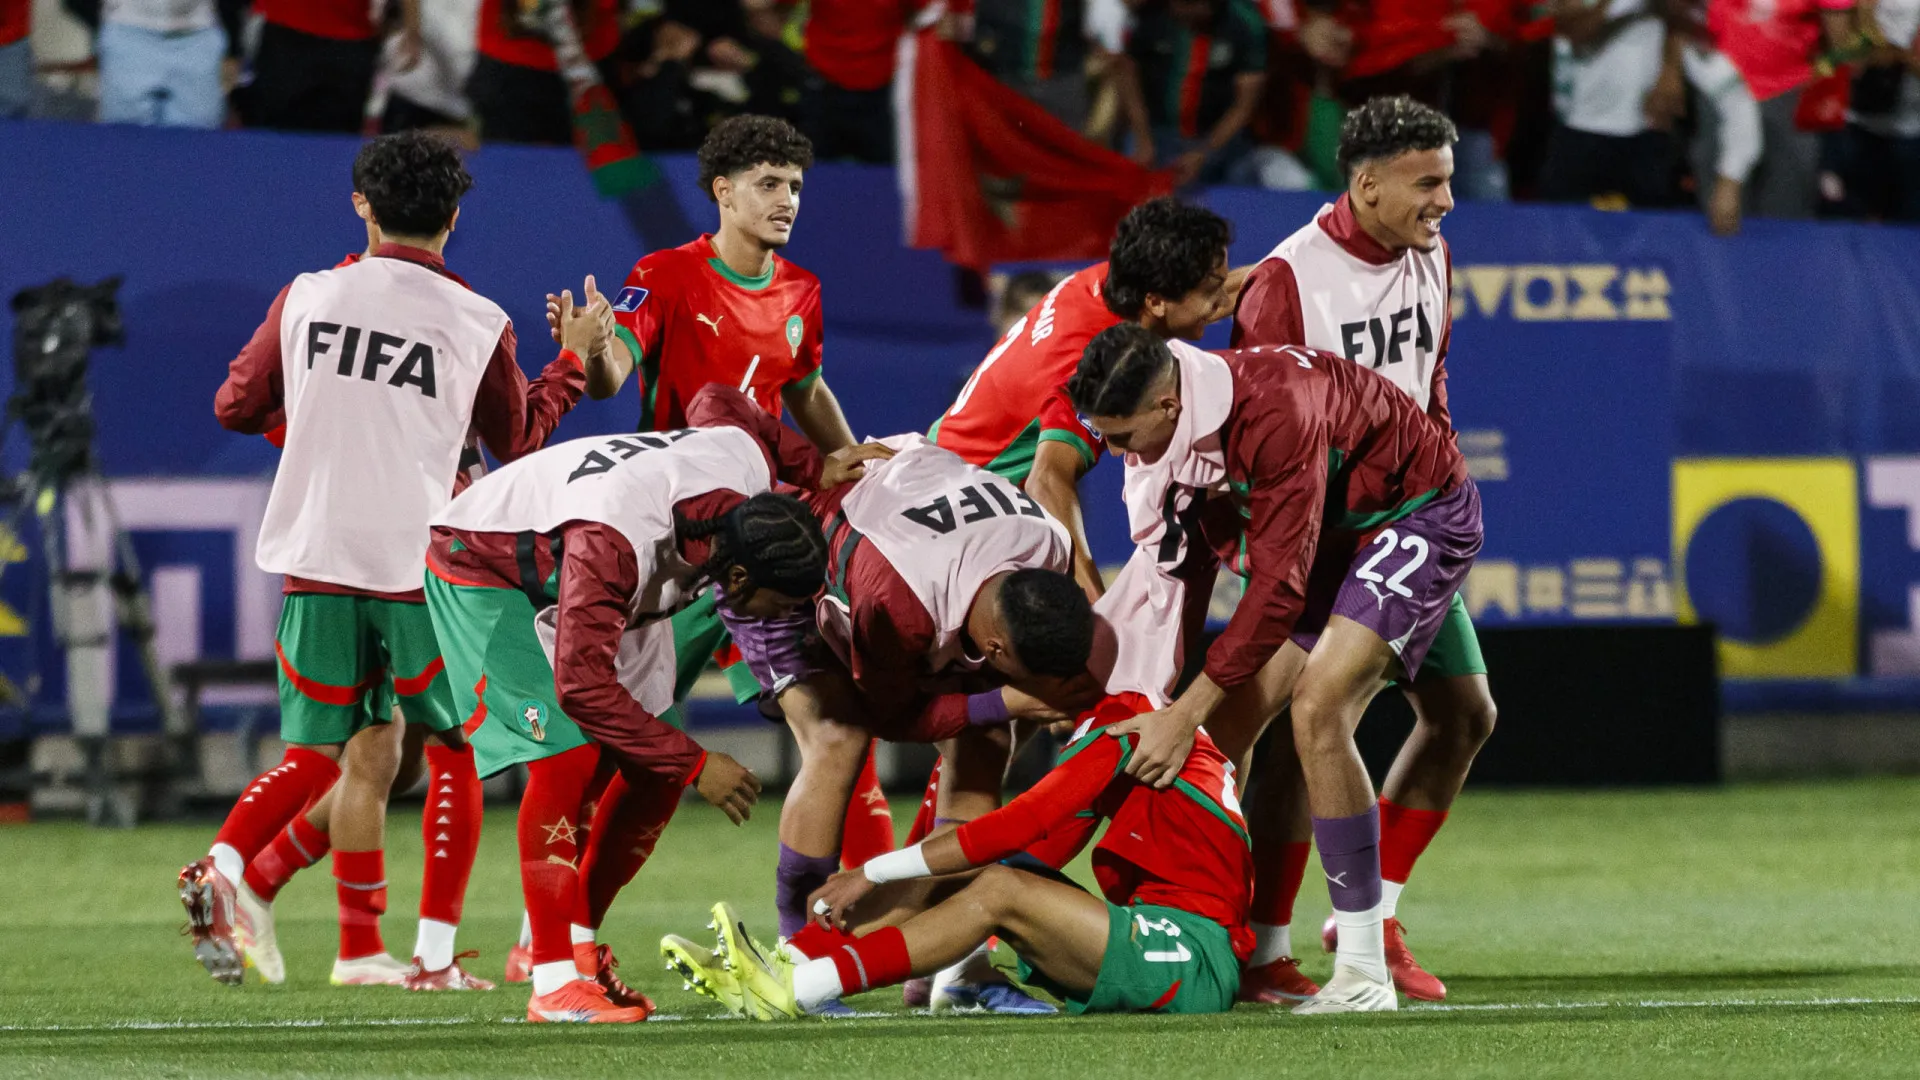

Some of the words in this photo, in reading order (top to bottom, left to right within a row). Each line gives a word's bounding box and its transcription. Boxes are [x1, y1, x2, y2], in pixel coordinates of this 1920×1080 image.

[307, 321, 438, 399] FIFA
[1340, 303, 1434, 369] FIFA
[900, 482, 1046, 534] FIFA
[1355, 528, 1429, 598] 22
